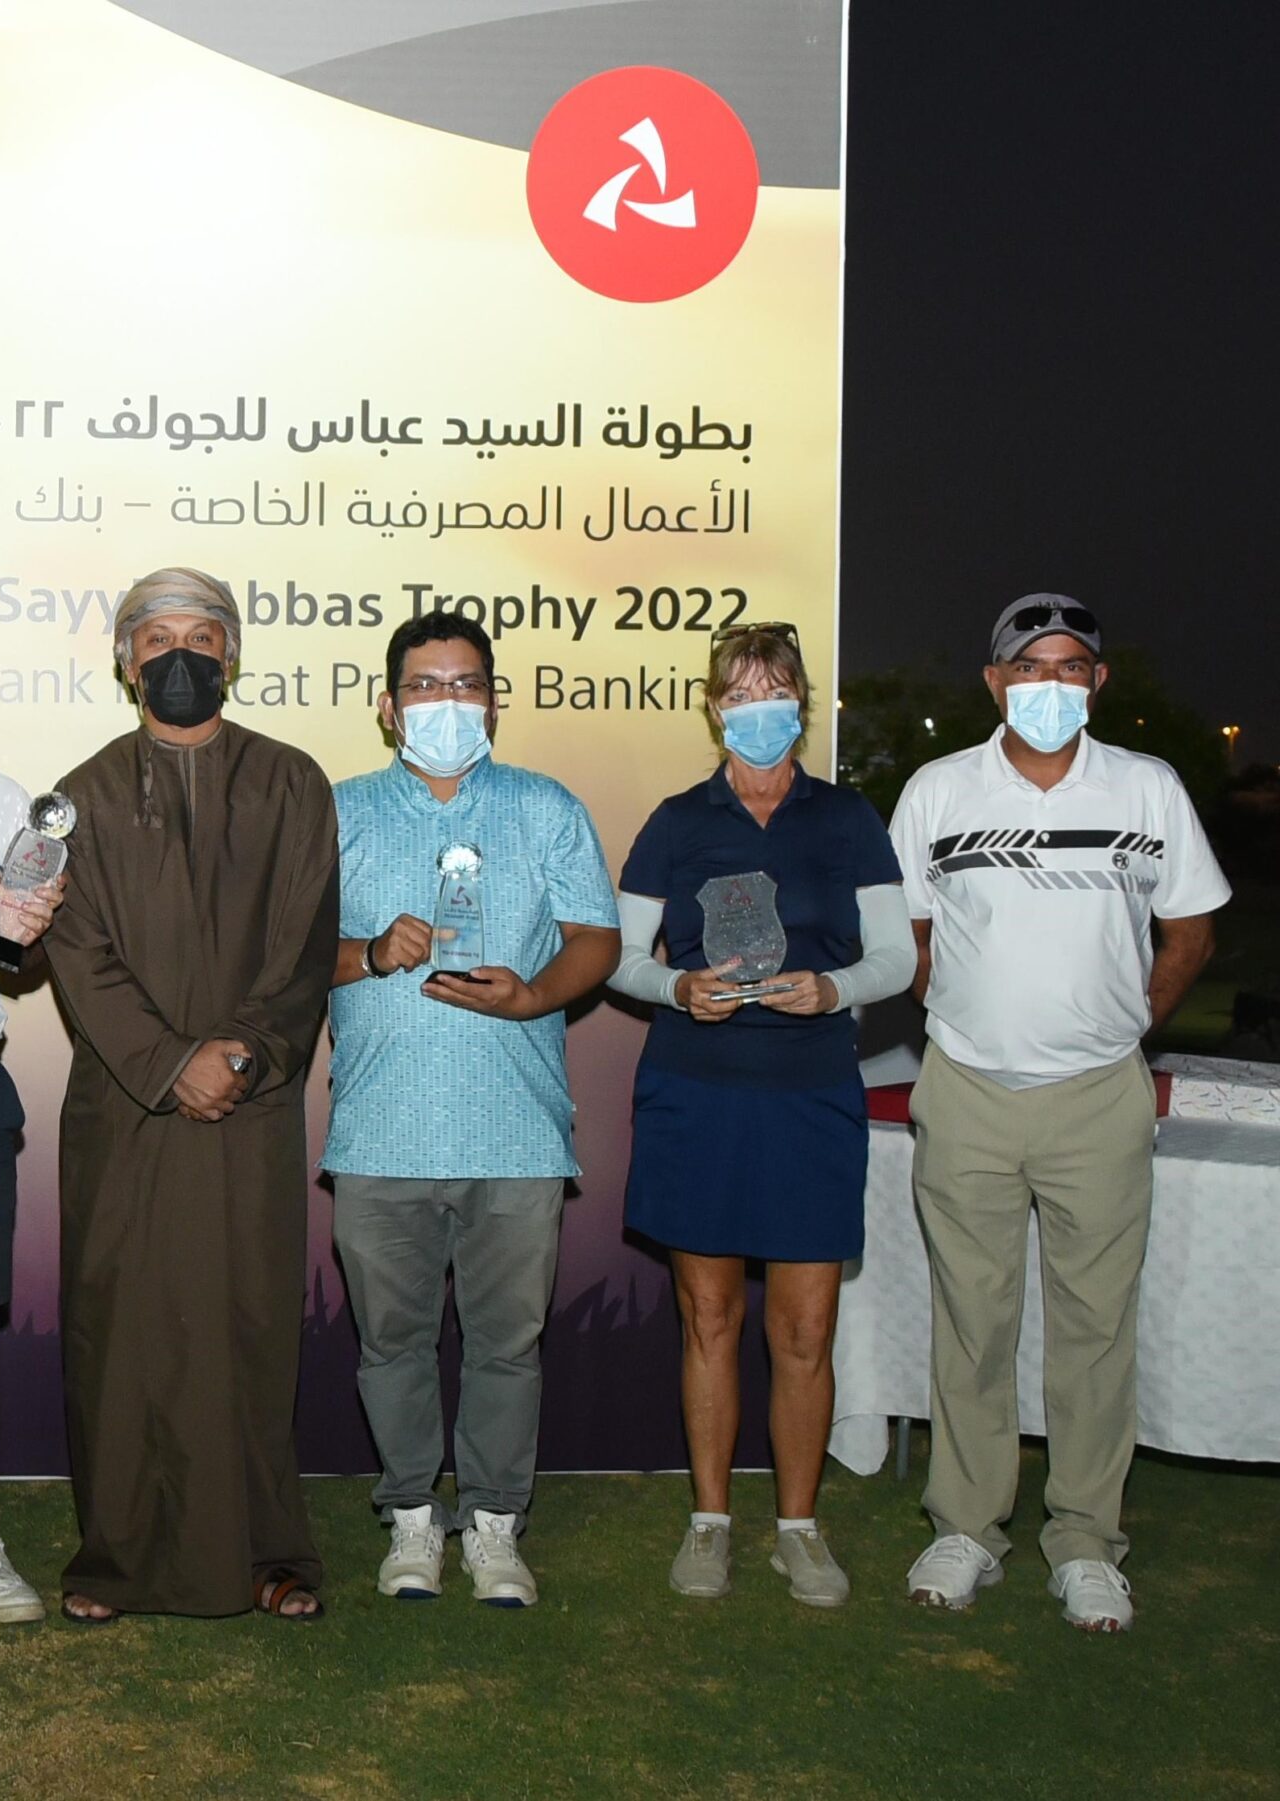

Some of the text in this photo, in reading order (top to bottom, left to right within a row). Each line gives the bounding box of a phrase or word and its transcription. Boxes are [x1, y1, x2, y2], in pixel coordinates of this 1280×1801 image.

[86, 394, 267, 455] للجولف
[286, 398, 423, 459] عباس
[441, 401, 582, 461] السيد
[602, 403, 753, 465] بطولة
[15, 476, 103, 534] بنك
[170, 479, 326, 527] الخاصة
[346, 484, 563, 540] المصرفية
[582, 478, 752, 542] الأعمال
[225, 578, 384, 628] bbas
[401, 583, 598, 641] Trophy
[614, 585, 748, 632] 2022
[535, 664, 710, 711] Bankin
